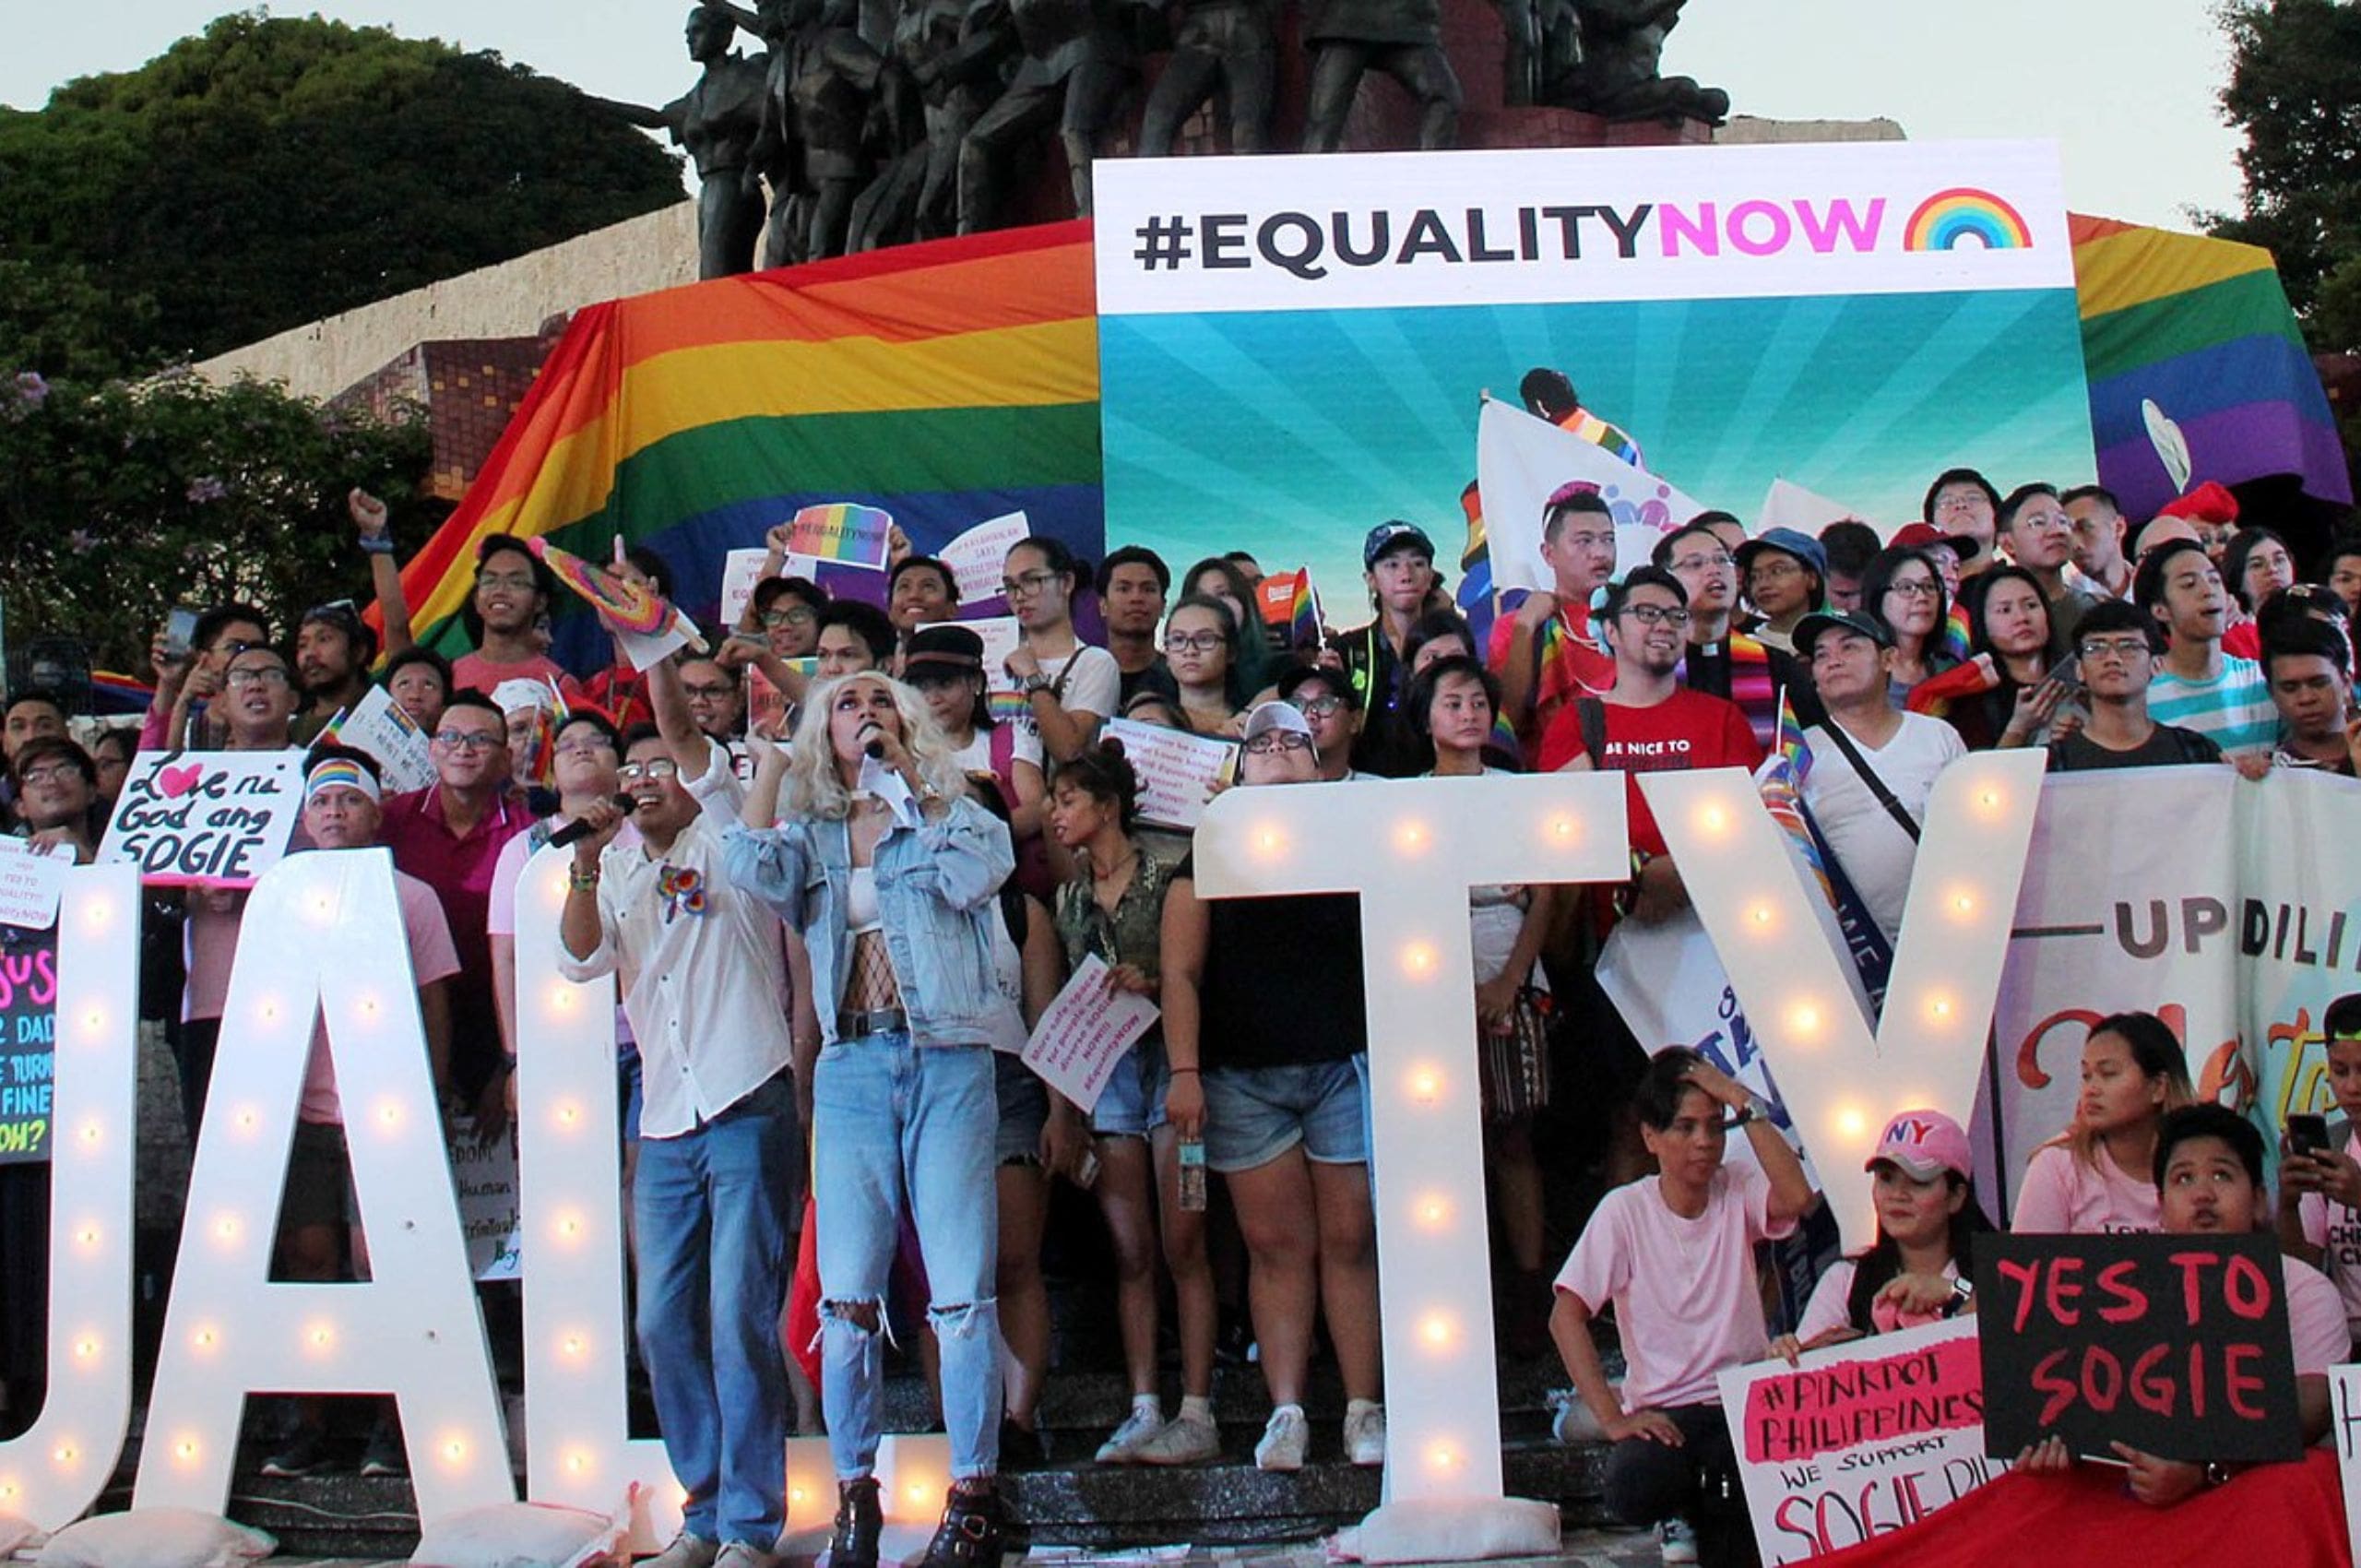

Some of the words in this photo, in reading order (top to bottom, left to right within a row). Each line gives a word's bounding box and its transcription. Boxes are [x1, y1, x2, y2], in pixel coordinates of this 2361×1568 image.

[1134, 197, 1887, 280] #EQUALITYNOW
[1606, 741, 1623, 755] BE
[1628, 741, 1664, 755] NICE
[1667, 739, 1691, 753] TO
[116, 797, 196, 832] God
[206, 807, 272, 835] ang
[122, 832, 265, 878] SOGIE
[2115, 897, 2228, 959] UP
[2241, 897, 2361, 971] DILI
[1031, 1032, 1051, 1061] More
[1050, 1006, 1068, 1030] safe
[1069, 968, 1101, 1006] spaces
[1059, 1008, 1086, 1047] people
[1062, 1029, 1087, 1072] diverse
[2, 1084, 52, 1114] FINE
[1886, 1119, 1934, 1145] NY
[1997, 1256, 2150, 1334] YES
[2168, 1251, 2272, 1327] TO
[1761, 1349, 1942, 1412] #PINKDOT
[2031, 1341, 2267, 1427] SOGIE
[1761, 1389, 1984, 1459] PHILIPPINES
[1781, 1465, 1822, 1491] WE
[1837, 1435, 1949, 1472] SUPPORT
[1774, 1471, 1935, 1559] SOGIE
